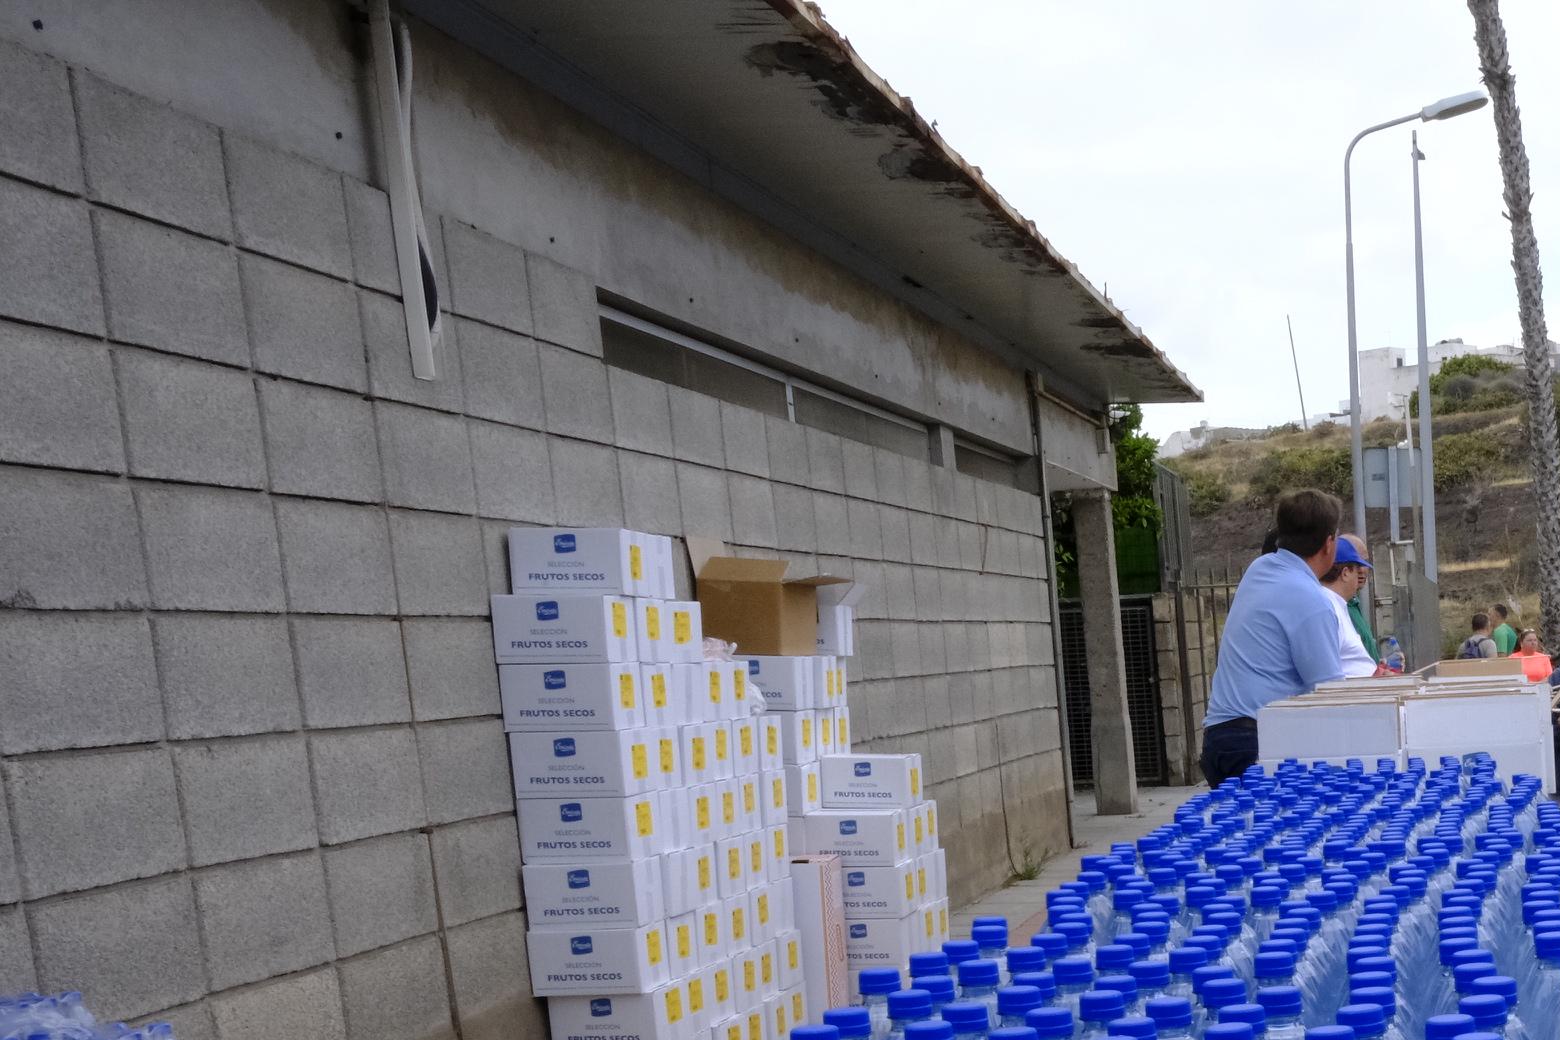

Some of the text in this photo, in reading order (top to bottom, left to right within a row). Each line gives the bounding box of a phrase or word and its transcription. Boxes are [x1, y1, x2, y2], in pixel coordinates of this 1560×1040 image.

[529, 573, 605, 581] FRUTOS SECOS
[511, 641, 588, 649] FRUTOS SECOS
[520, 709, 596, 717] FRUTOS SECOS
[530, 776, 605, 784] FRUTOS SECOS
[537, 841, 577, 849] FRUTOS
[544, 907, 620, 917] FRUTOS SECOS
